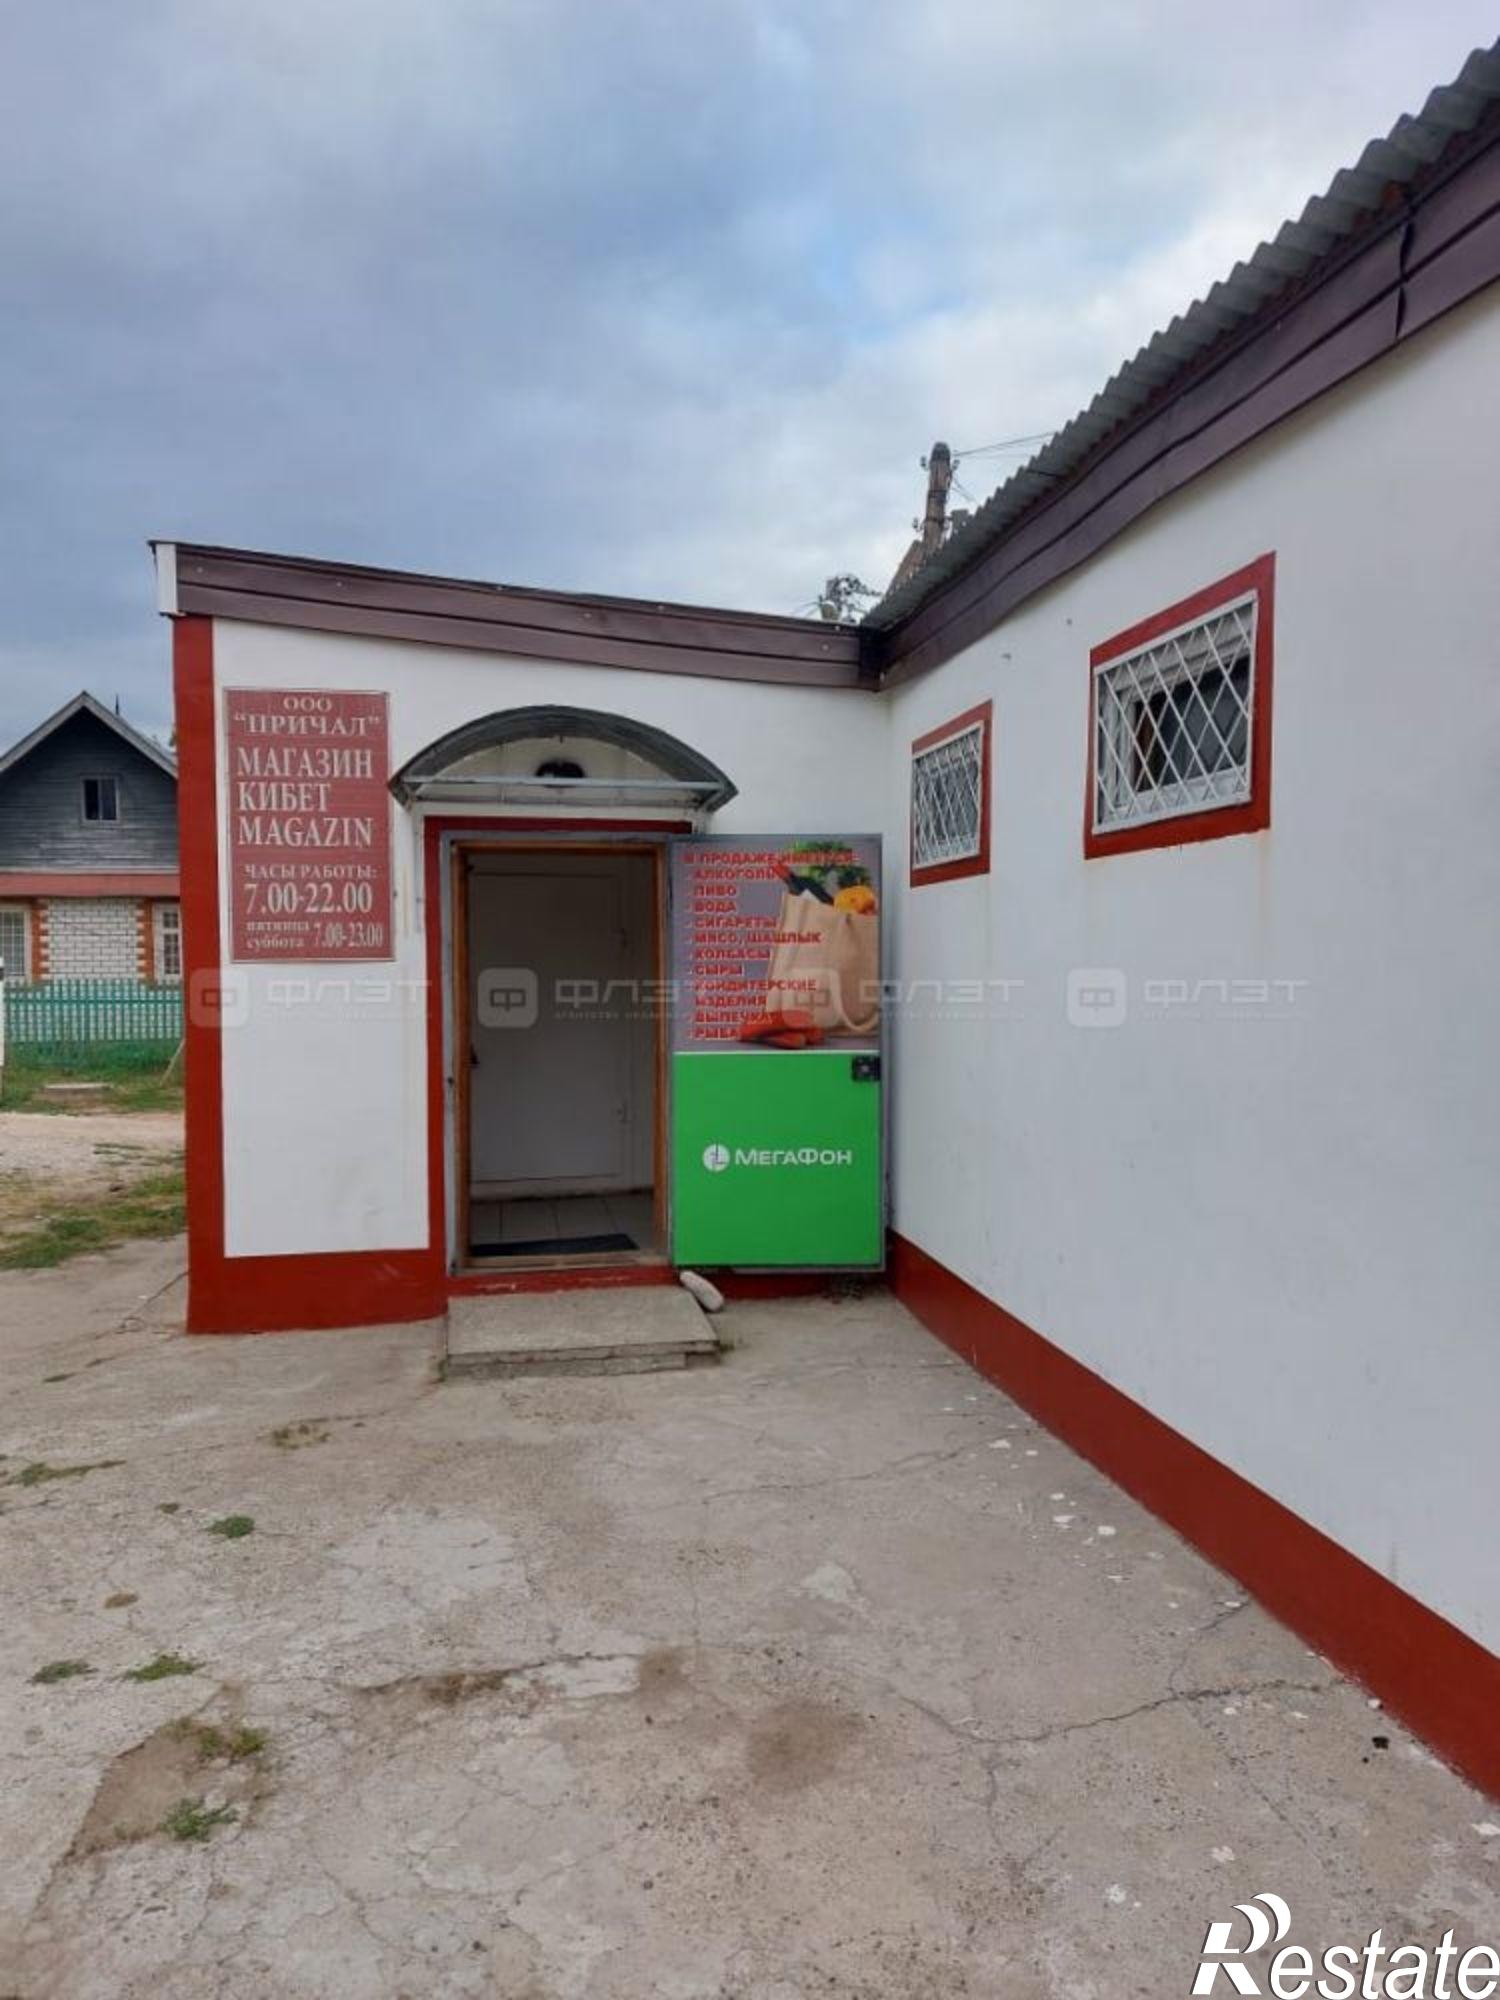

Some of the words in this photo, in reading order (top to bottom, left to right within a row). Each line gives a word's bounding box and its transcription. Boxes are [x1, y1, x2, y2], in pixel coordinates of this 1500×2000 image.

[283, 697, 332, 712] ООО
[237, 747, 373, 778] МАГАЗИН
[238, 781, 331, 812] КИБЕТ
[238, 816, 373, 848] MAGAZIN
[244, 863, 295, 879] ЧАСЫ
[244, 882, 373, 915] 7.00-22.00
